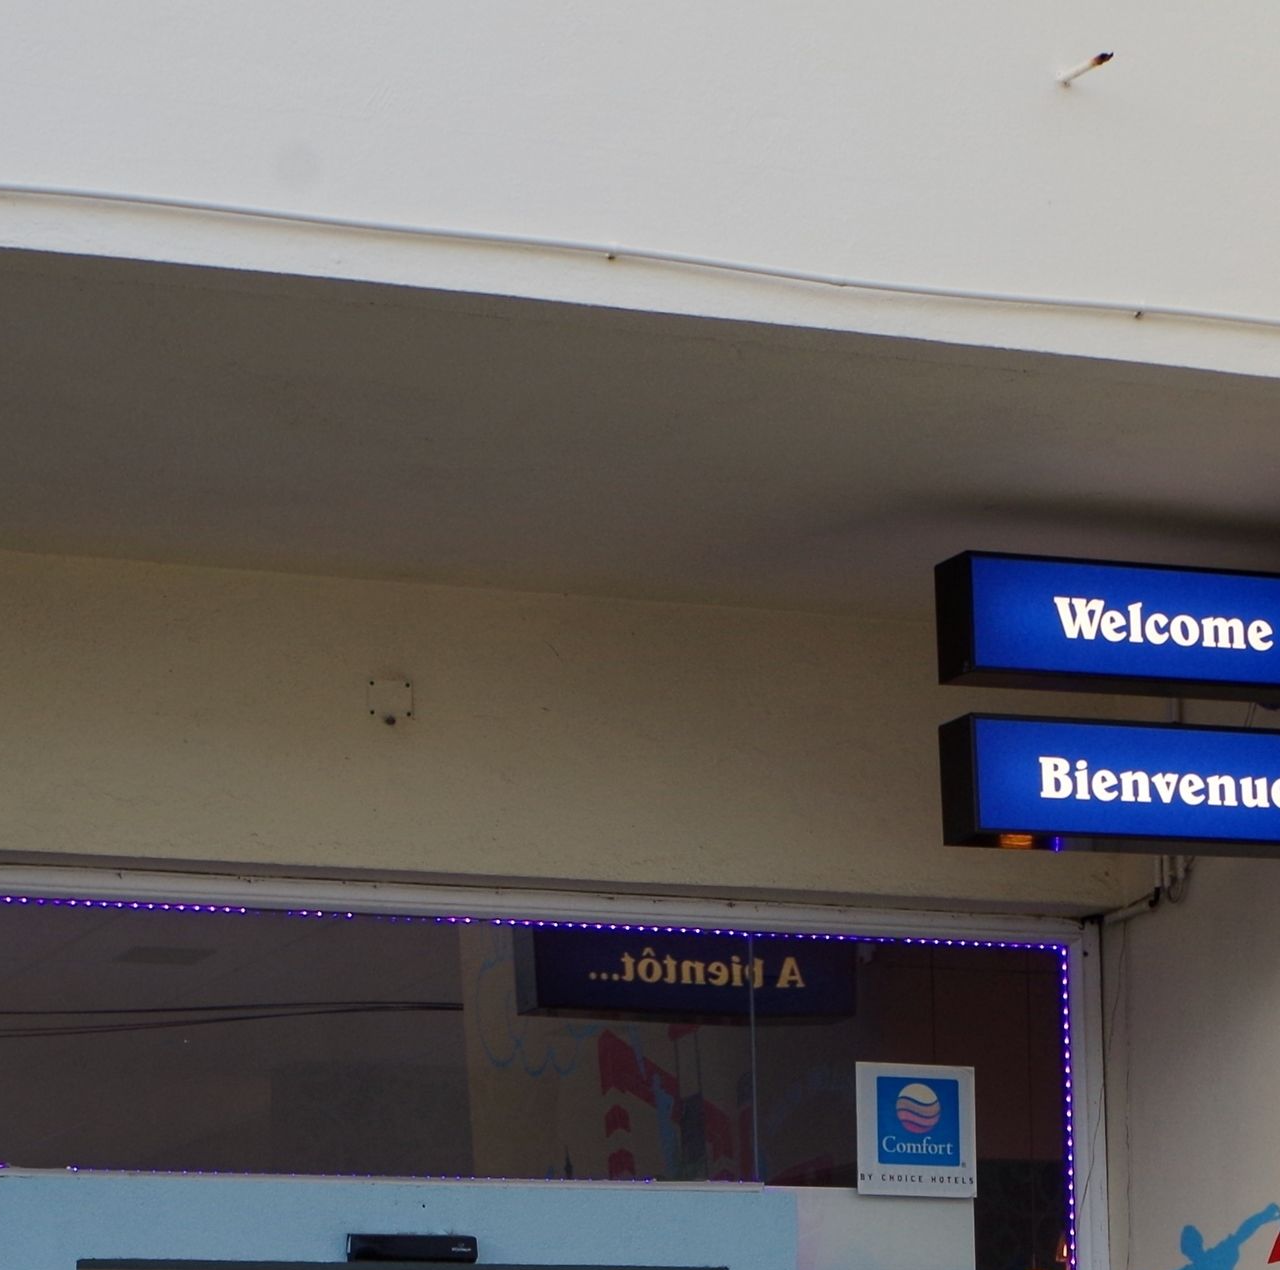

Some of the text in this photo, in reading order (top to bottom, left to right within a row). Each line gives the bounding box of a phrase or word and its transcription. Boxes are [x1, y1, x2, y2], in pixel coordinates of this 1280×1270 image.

[1053, 595, 1274, 652] Welcome
[881, 1135, 954, 1156] Comfort
[860, 1173, 975, 1186] BY CHOICE HOTELS
